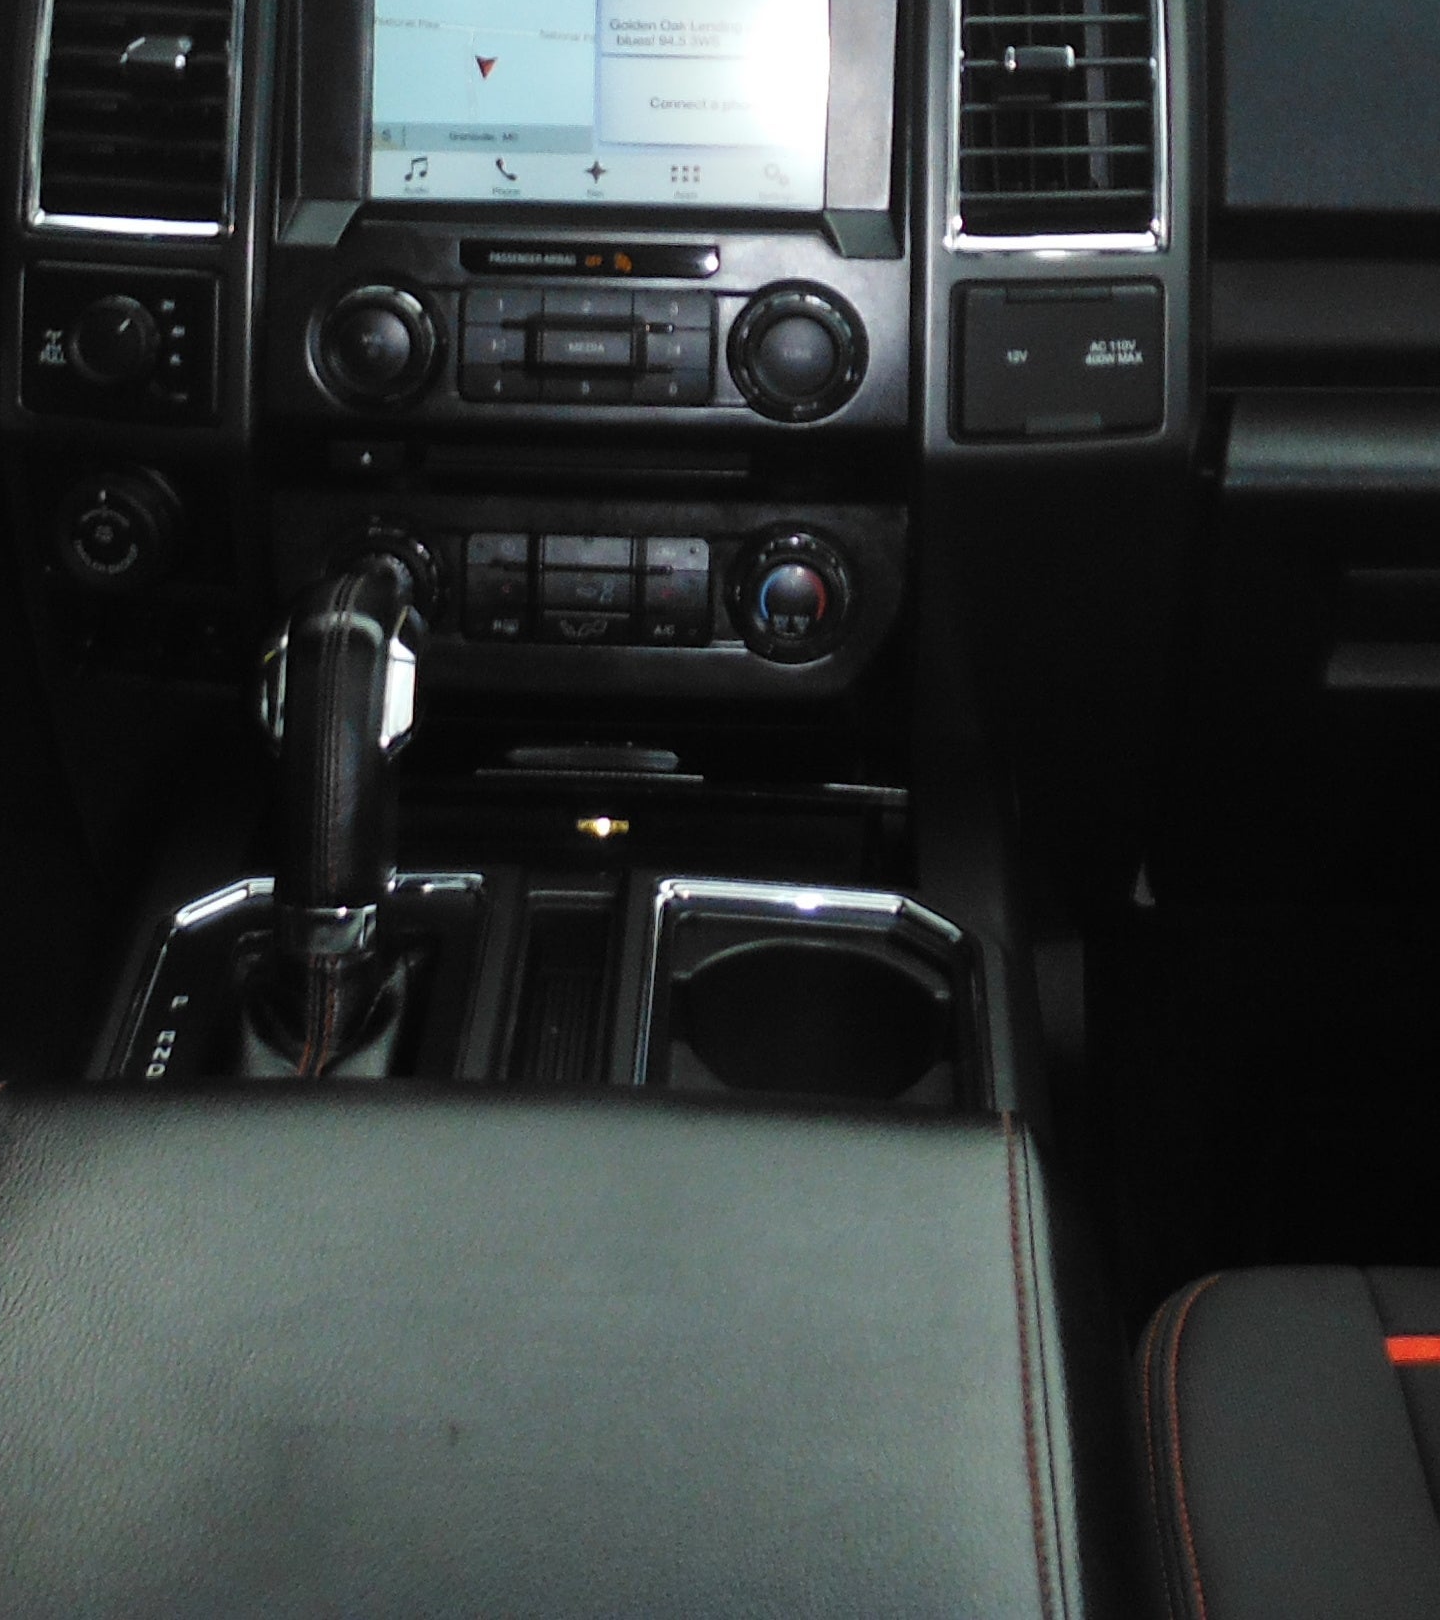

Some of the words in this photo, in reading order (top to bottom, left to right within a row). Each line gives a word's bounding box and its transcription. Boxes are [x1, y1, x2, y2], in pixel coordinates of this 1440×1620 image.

[610, 18, 657, 32] Golden
[649, 97, 707, 110] Connect
[568, 341, 605, 352] MEDIA
[152, 1046, 172, 1060] N
[145, 1063, 166, 1077] D
